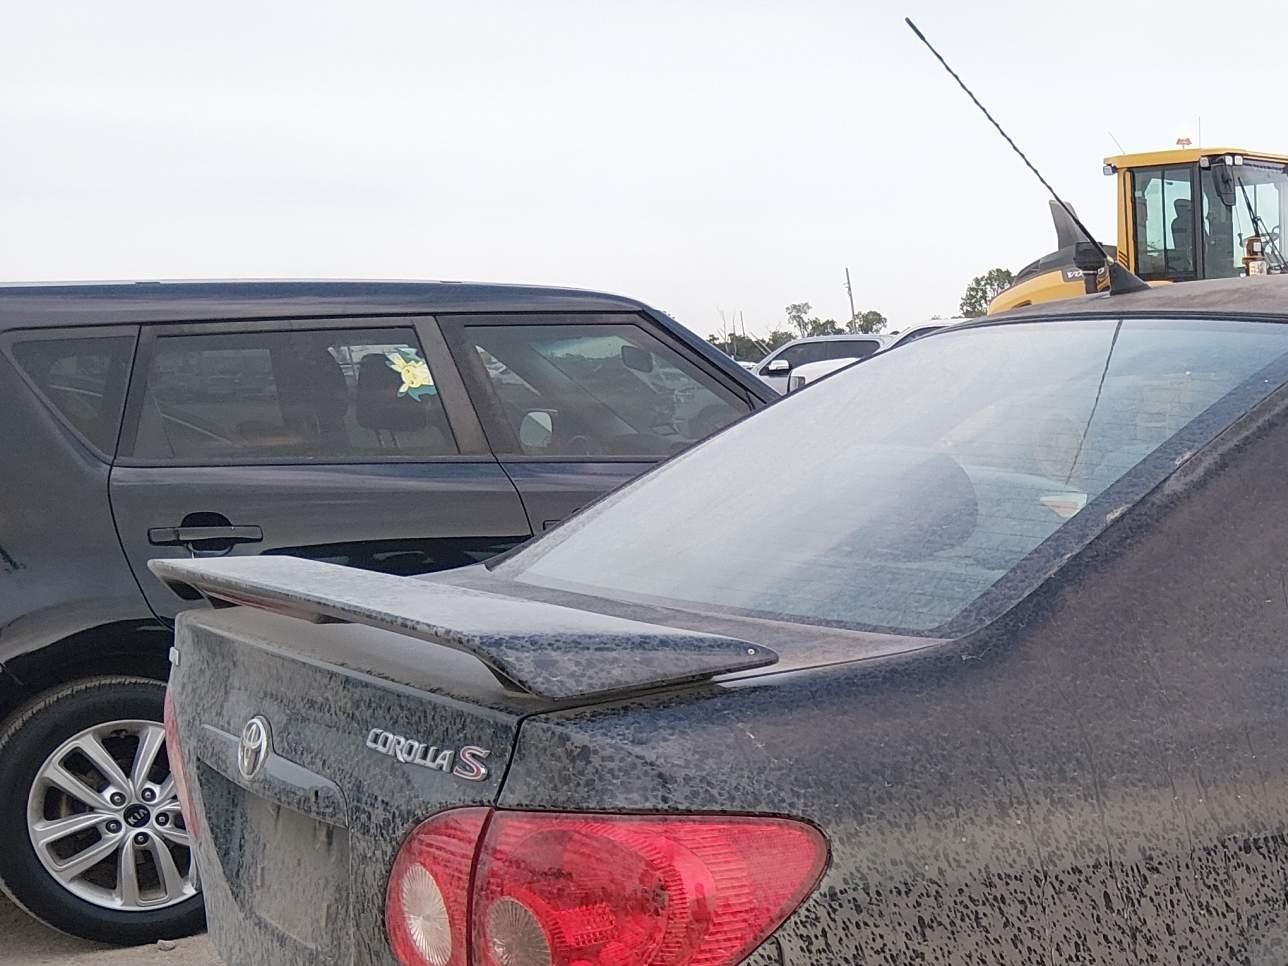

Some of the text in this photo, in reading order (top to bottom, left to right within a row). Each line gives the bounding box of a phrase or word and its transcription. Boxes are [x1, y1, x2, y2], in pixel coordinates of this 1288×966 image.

[366, 728, 491, 782] COROLLA S
[127, 809, 148, 825] KIA
